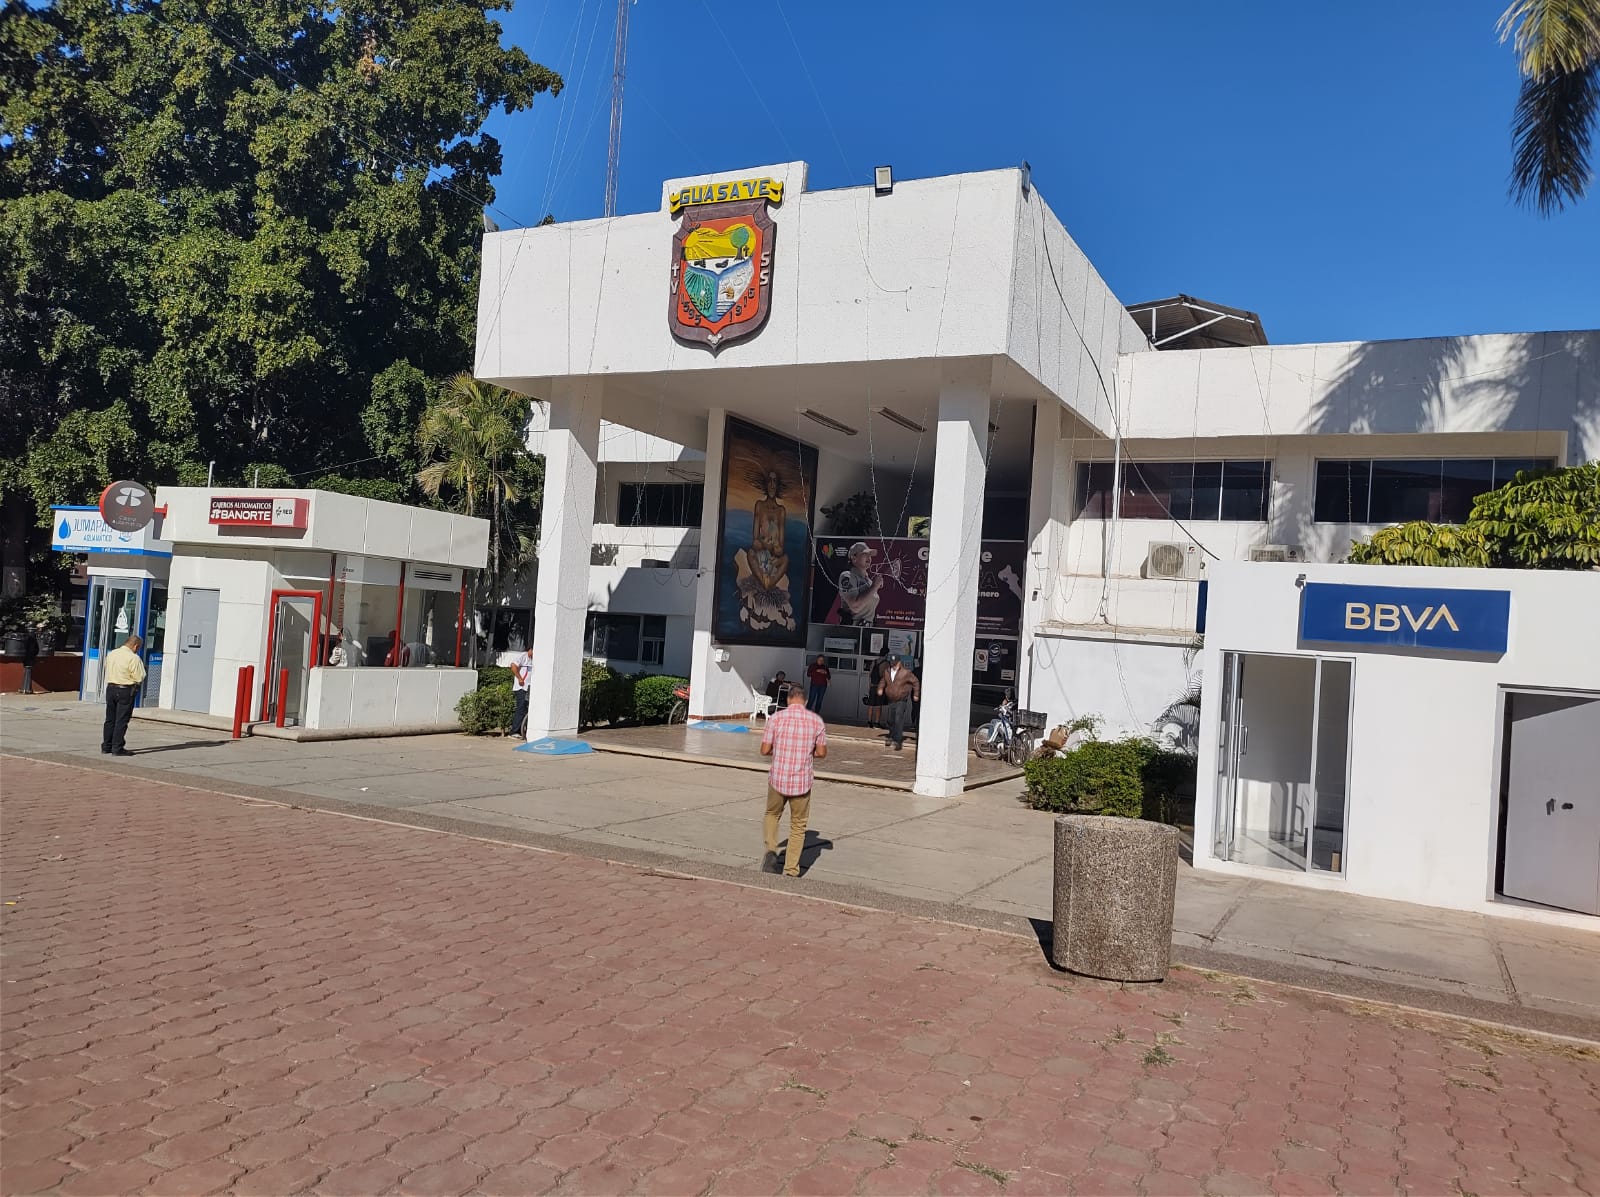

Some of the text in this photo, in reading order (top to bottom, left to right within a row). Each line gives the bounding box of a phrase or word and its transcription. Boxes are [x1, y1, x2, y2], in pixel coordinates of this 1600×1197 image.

[680, 180, 770, 204] GUASAVE
[212, 501, 272, 510] CAJEROS AUTOMATICOS
[220, 509, 271, 521] BANORTE
[1344, 602, 1460, 633] BBVA
